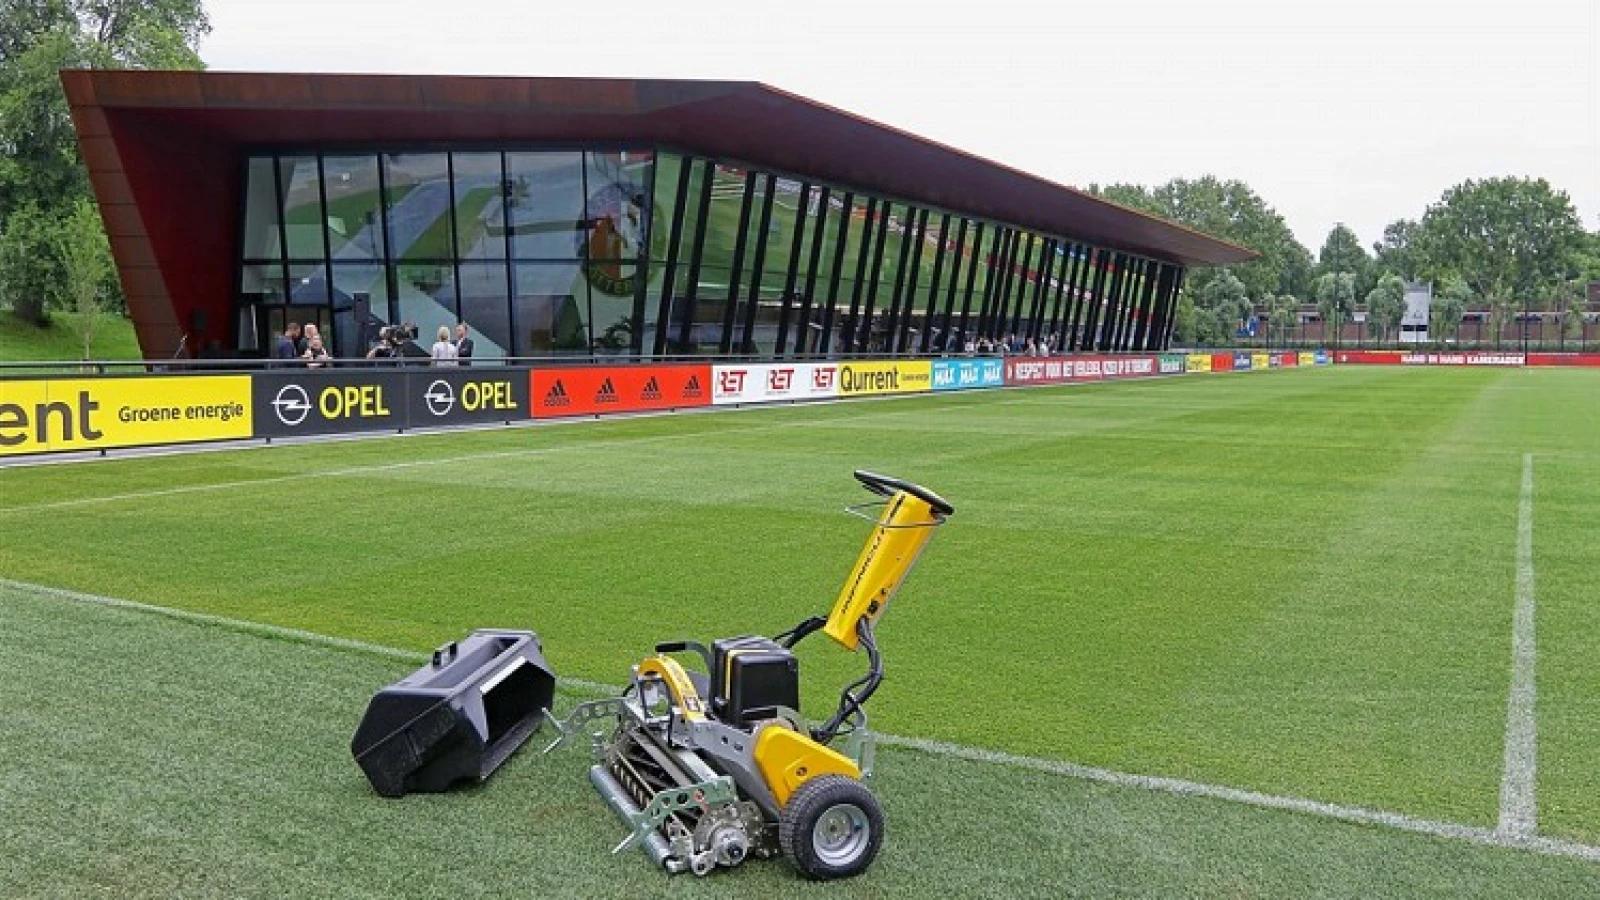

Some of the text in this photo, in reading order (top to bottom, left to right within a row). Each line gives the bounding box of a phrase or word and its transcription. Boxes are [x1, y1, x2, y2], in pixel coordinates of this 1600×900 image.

[840, 365, 899, 392] Qurrent
[319, 384, 390, 420] OPEL
[461, 380, 517, 412] OPEL
[118, 402, 244, 422] Groene energie
